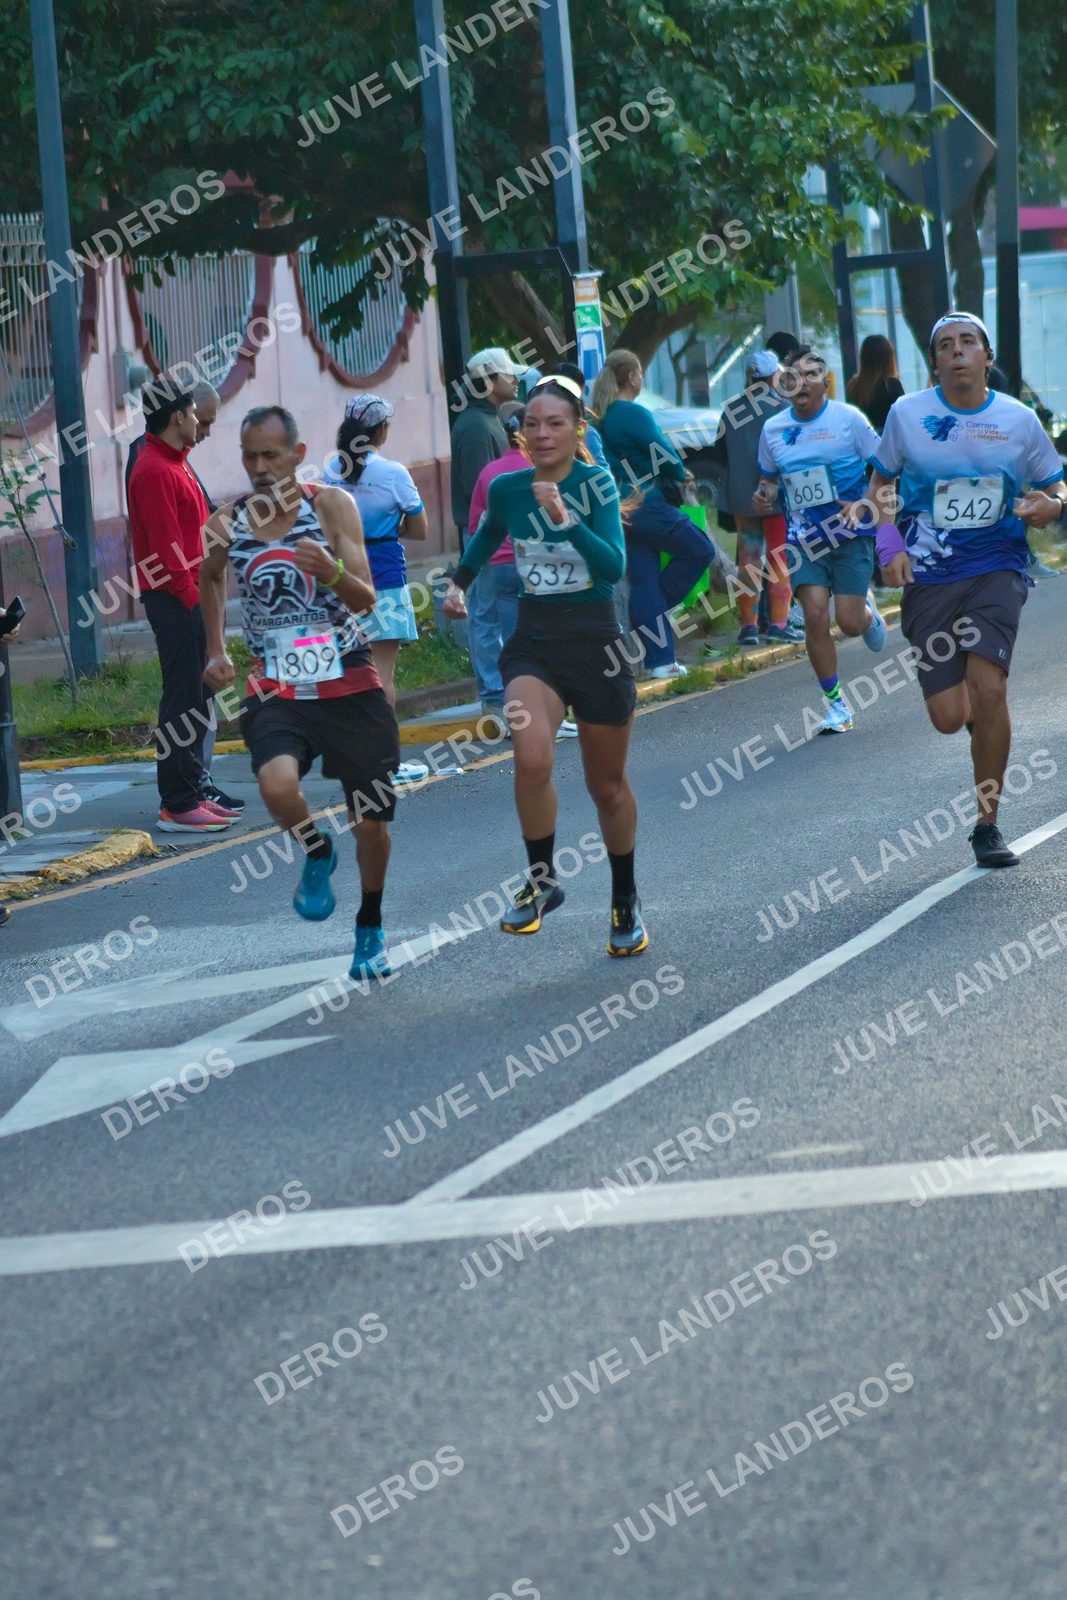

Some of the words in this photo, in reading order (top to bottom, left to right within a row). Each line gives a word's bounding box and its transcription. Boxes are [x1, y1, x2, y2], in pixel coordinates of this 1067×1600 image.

[794, 483, 824, 504] 605
[944, 498, 992, 521] 542
[528, 562, 578, 586] 632
[270, 647, 335, 679] 1809
